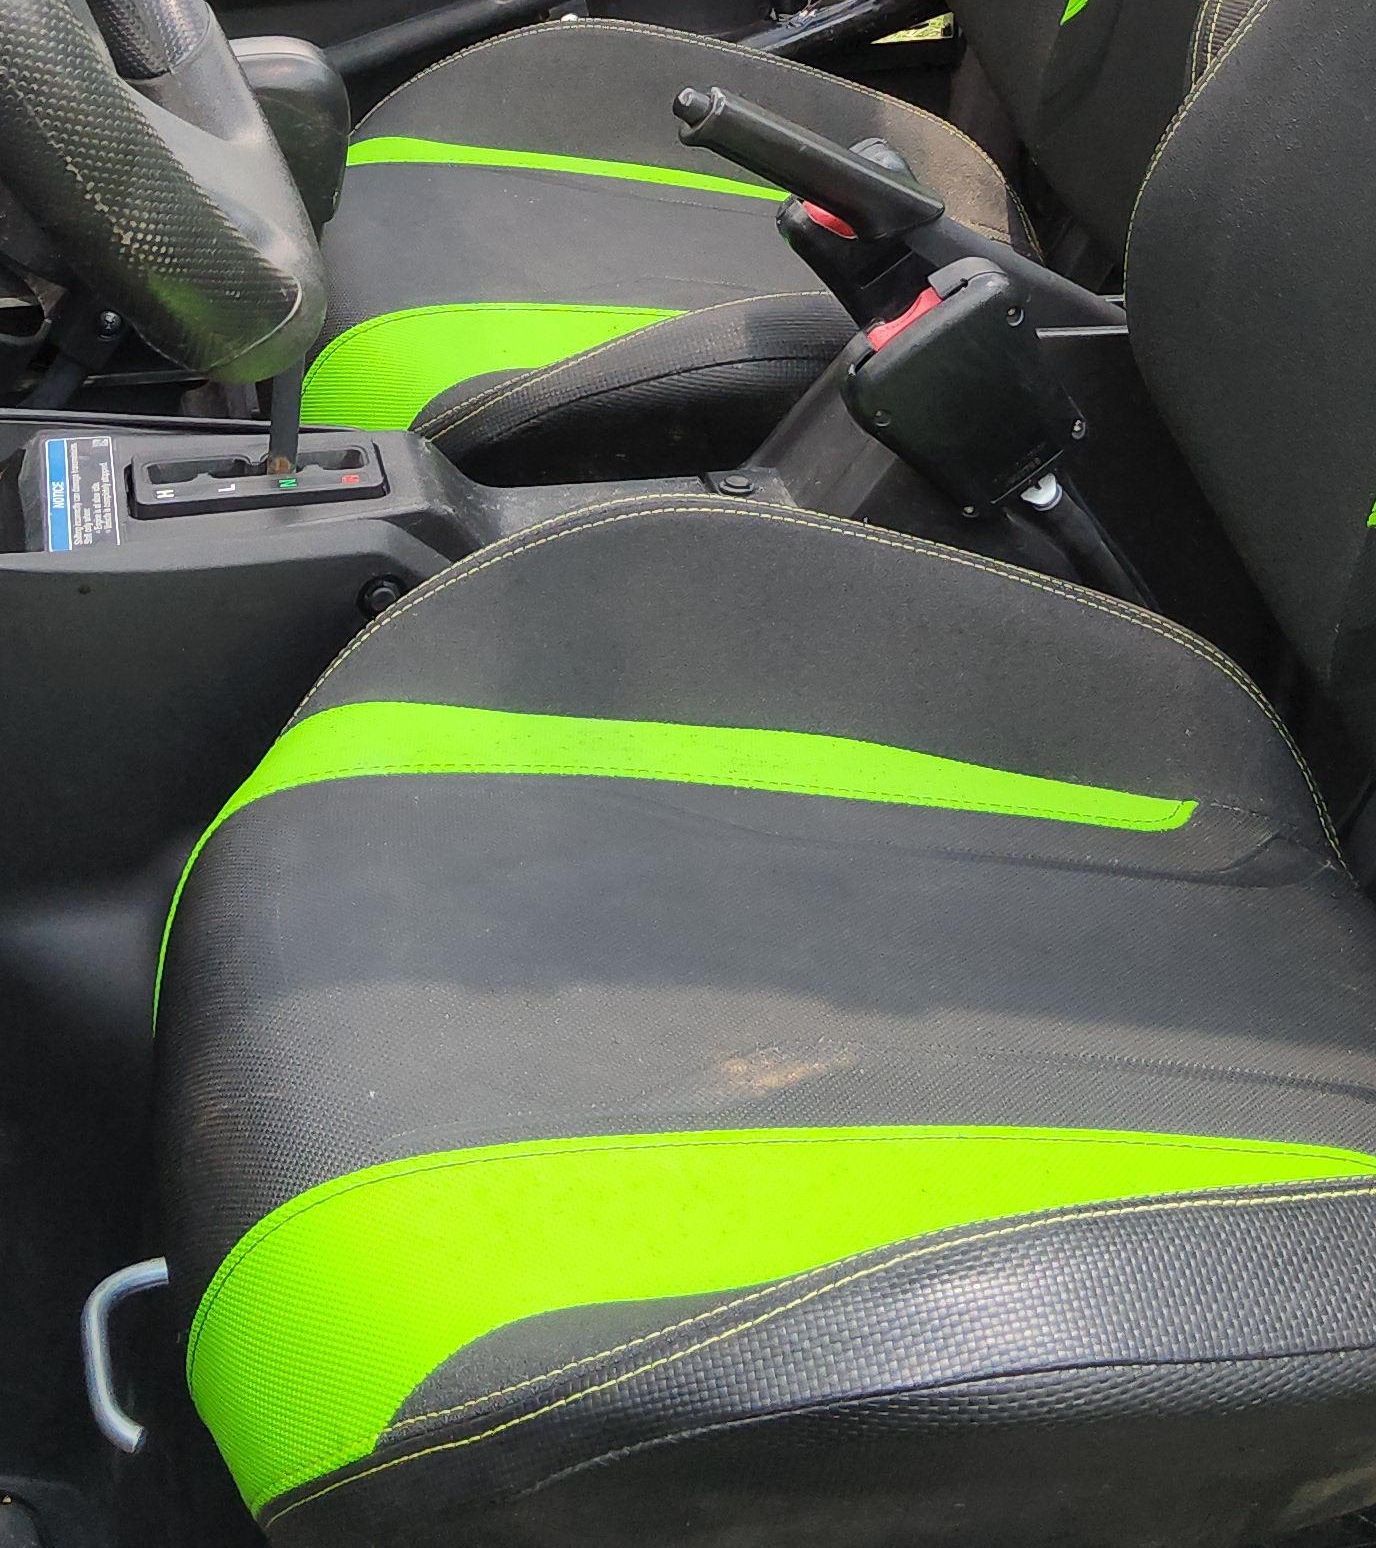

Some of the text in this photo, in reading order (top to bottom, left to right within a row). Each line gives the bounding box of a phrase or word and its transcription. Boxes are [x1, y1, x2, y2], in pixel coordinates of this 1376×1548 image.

[217, 483, 236, 493] L
[278, 478, 297, 488] N
[51, 481, 65, 509] NOTICE
[156, 489, 174, 499] H
